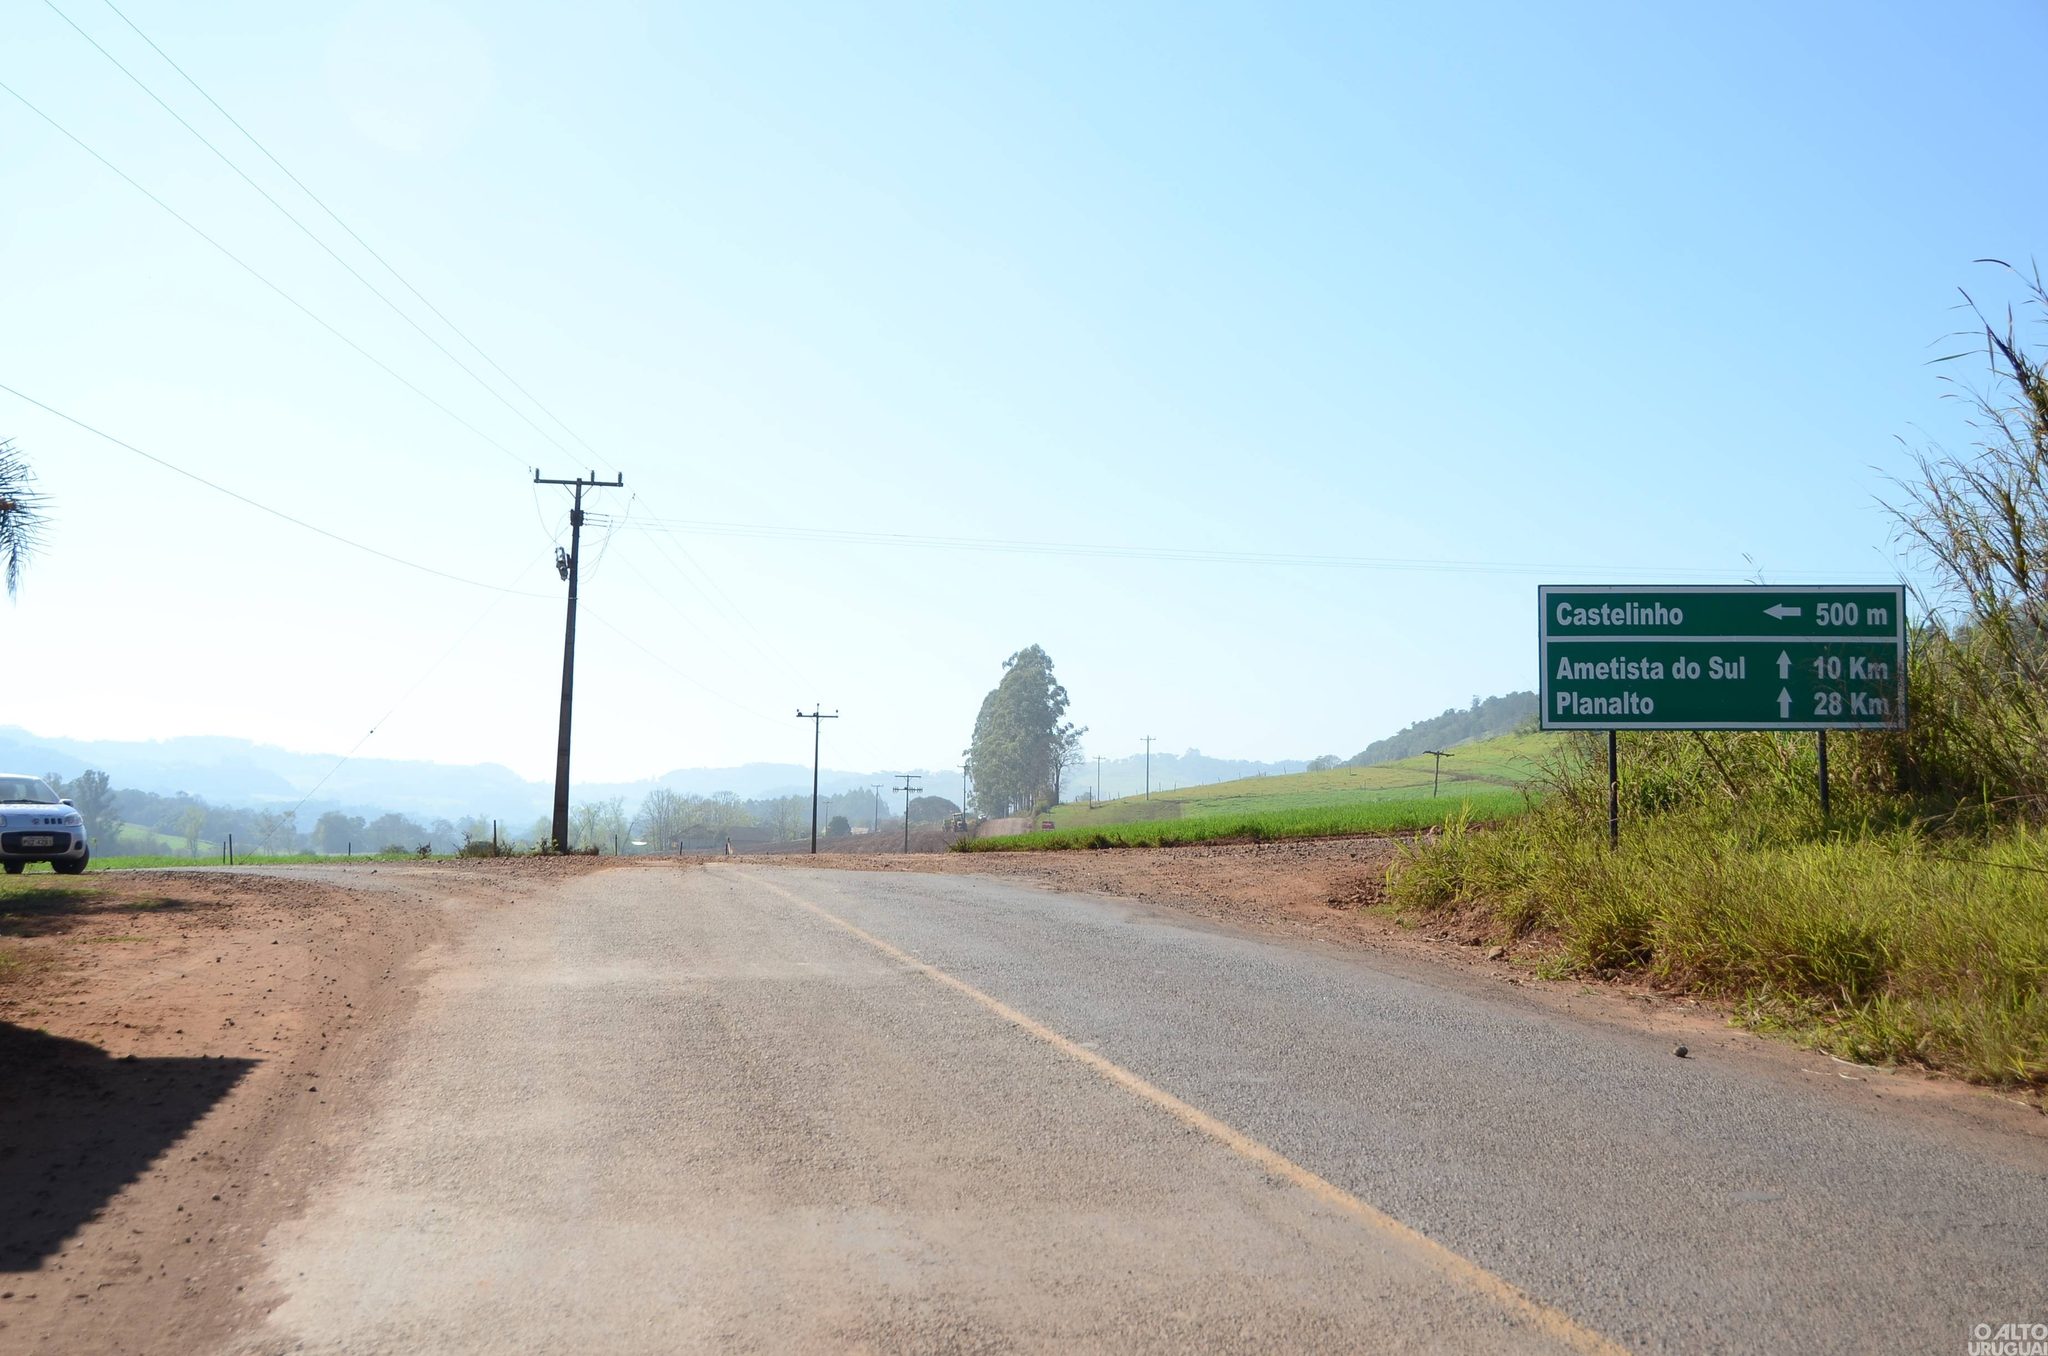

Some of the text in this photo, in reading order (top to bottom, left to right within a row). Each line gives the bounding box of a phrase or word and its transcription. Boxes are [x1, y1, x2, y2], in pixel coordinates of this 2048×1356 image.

[1556, 602, 1888, 626] Castelinho 500 m
[1556, 656, 1888, 680] Ametista do Sul 10 Km
[1556, 691, 1888, 715] Planalto 28 Km
